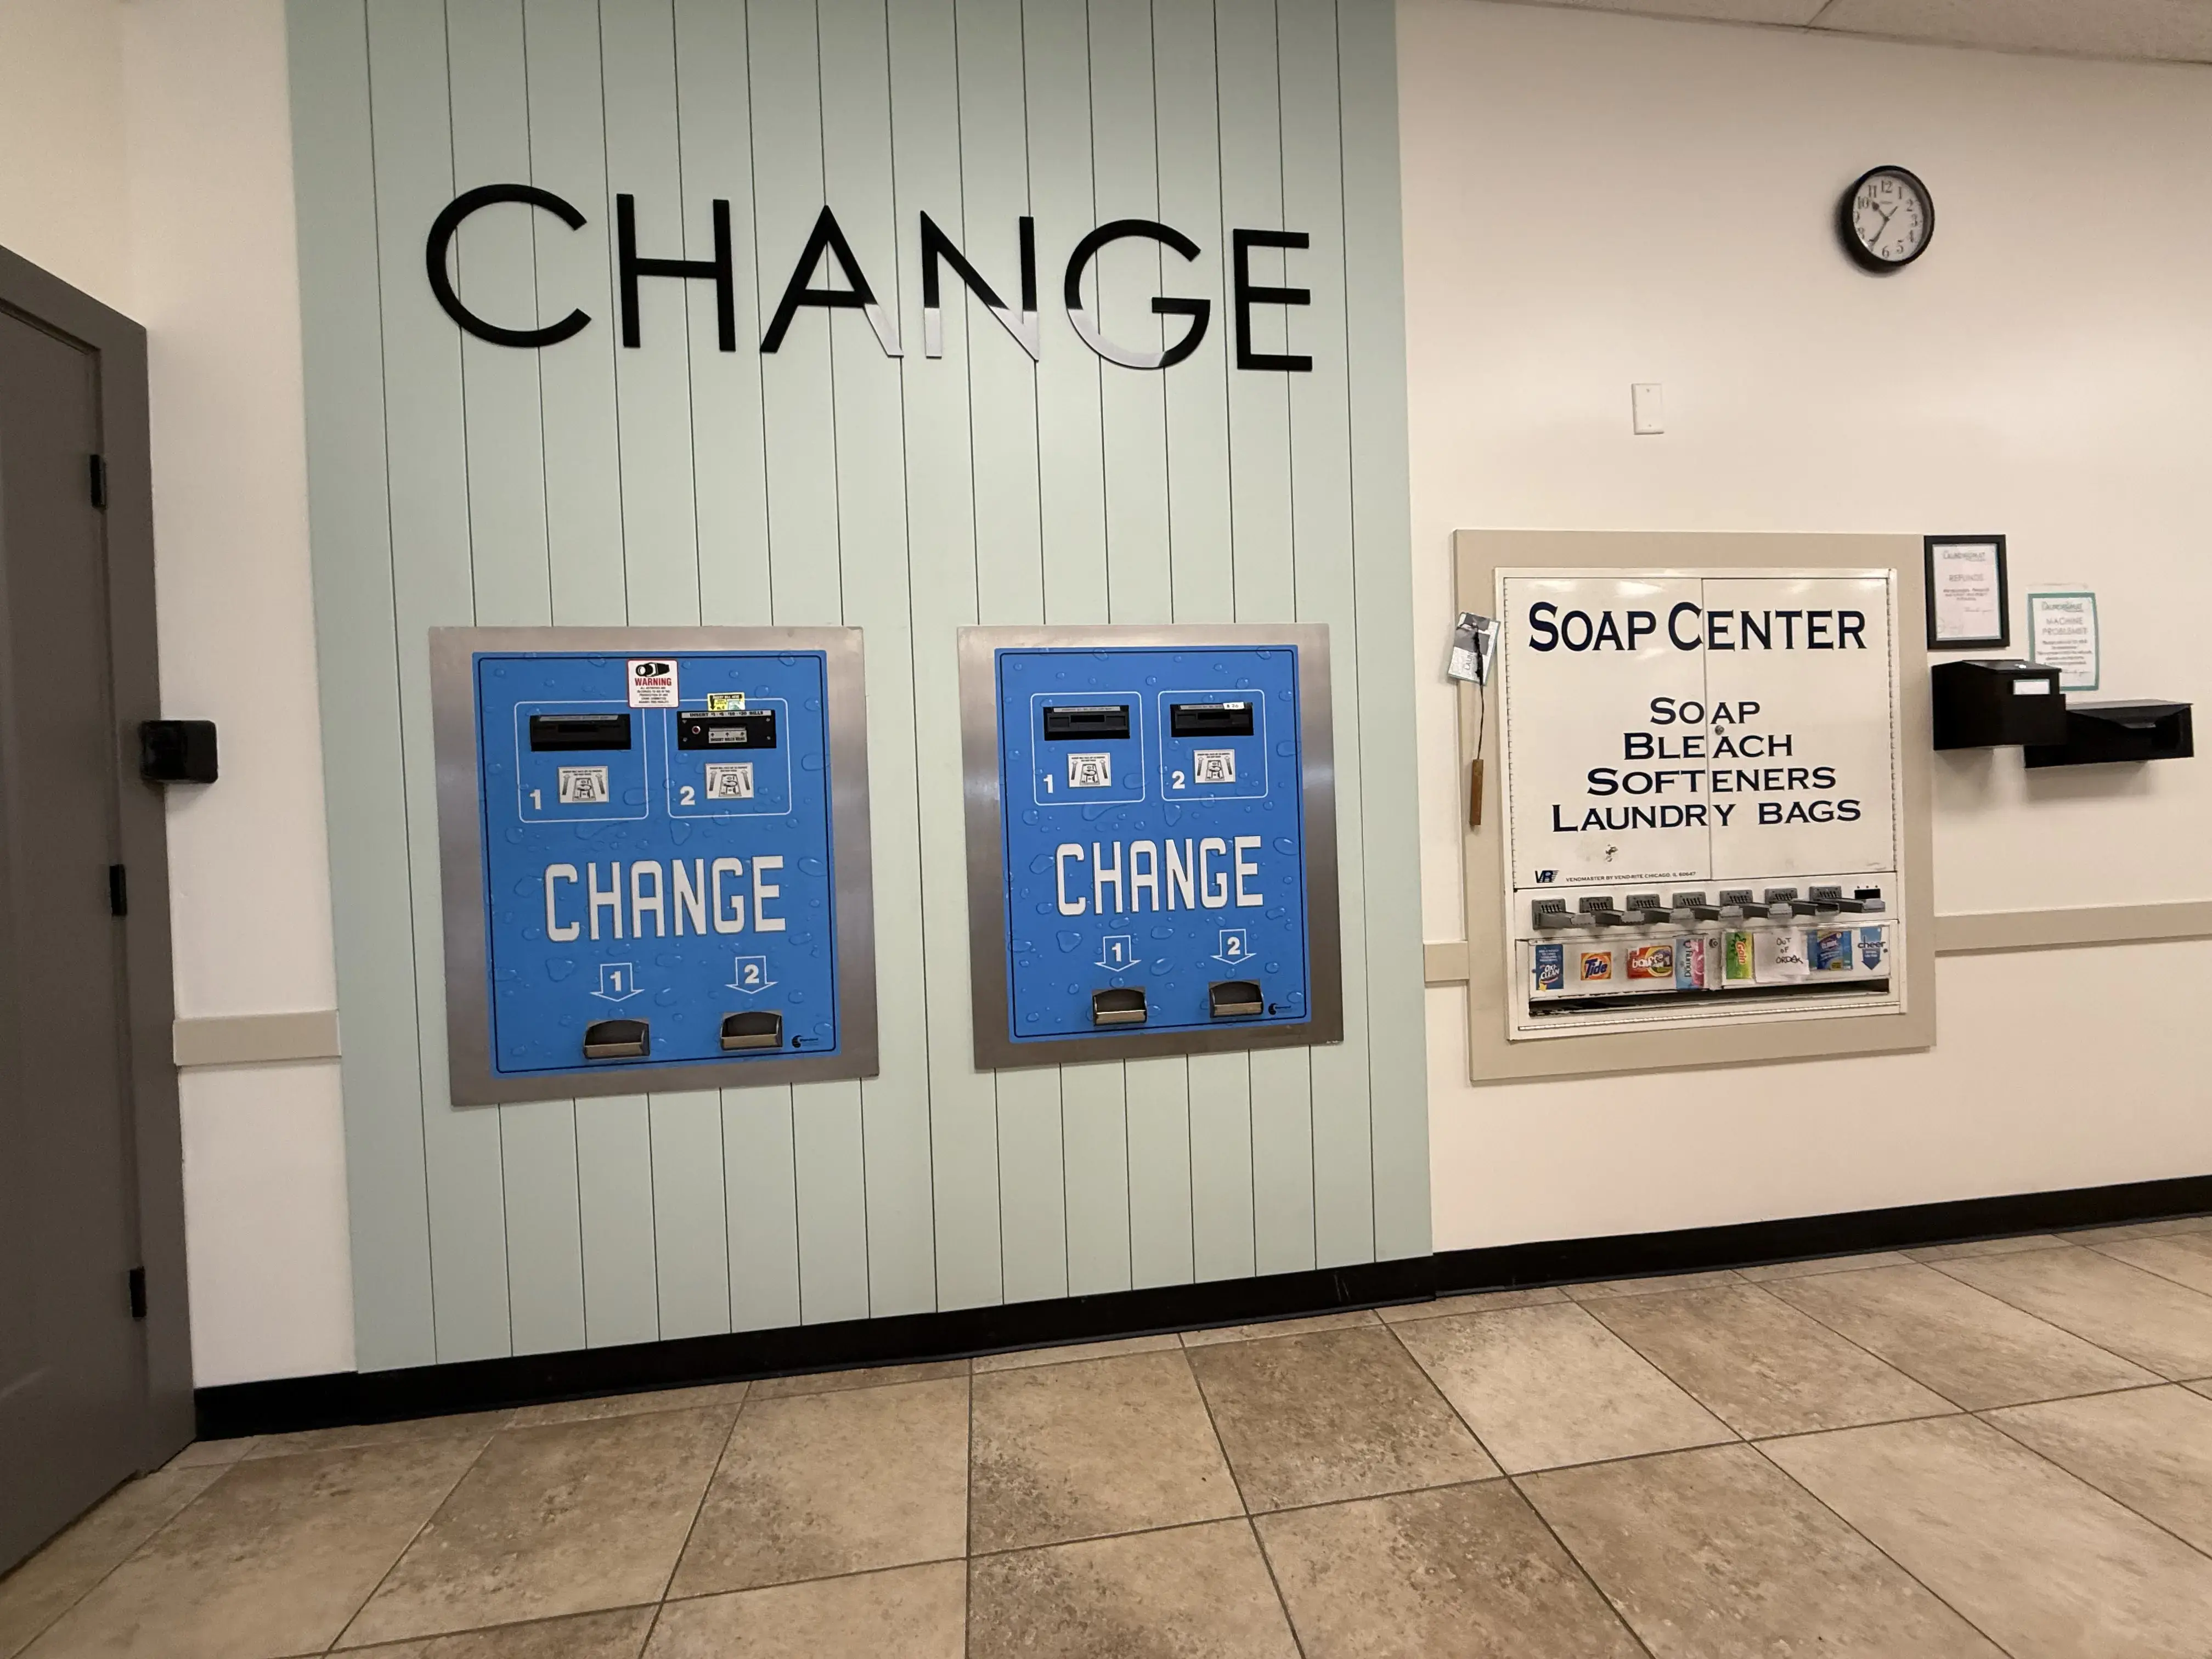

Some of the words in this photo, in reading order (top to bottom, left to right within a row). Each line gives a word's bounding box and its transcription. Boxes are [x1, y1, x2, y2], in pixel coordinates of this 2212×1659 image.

[1868, 185, 1877, 198] 11
[1881, 180, 1892, 193] 12
[1898, 186, 1902, 200] 1
[1858, 196, 1869, 210] 10
[1906, 199, 1914, 212] 2
[1911, 213, 1918, 227] 3
[1882, 246, 1889, 258] 6
[1897, 239, 1904, 253] 5
[426, 184, 1312, 372] CHANGE
[1529, 601, 1657, 652] SOAP
[1668, 601, 1868, 652] CENTER
[634, 678, 672, 686] WARNING
[1650, 697, 1760, 725] SOAP
[1623, 732, 1793, 760] BLEACH
[1043, 774, 1053, 794] 1
[1172, 771, 1186, 789] 2
[1587, 766, 1836, 795] SOFTENERS
[530, 789, 542, 810] 1
[680, 786, 696, 806] 2
[1551, 804, 1737, 832] LAUNDRY
[1758, 799, 1861, 825] BAGS
[1056, 836, 1263, 916] CHANGE
[544, 855, 787, 943] CHANGE
[1227, 936, 1240, 956] 2
[1857, 935, 1886, 949] cheer
[1111, 943, 1122, 962] 1
[1736, 942, 1747, 964] Gain
[1775, 955, 1804, 964] ORDER
[744, 964, 760, 984] 2
[1585, 958, 1608, 979] Tide
[610, 970, 622, 992] 1
